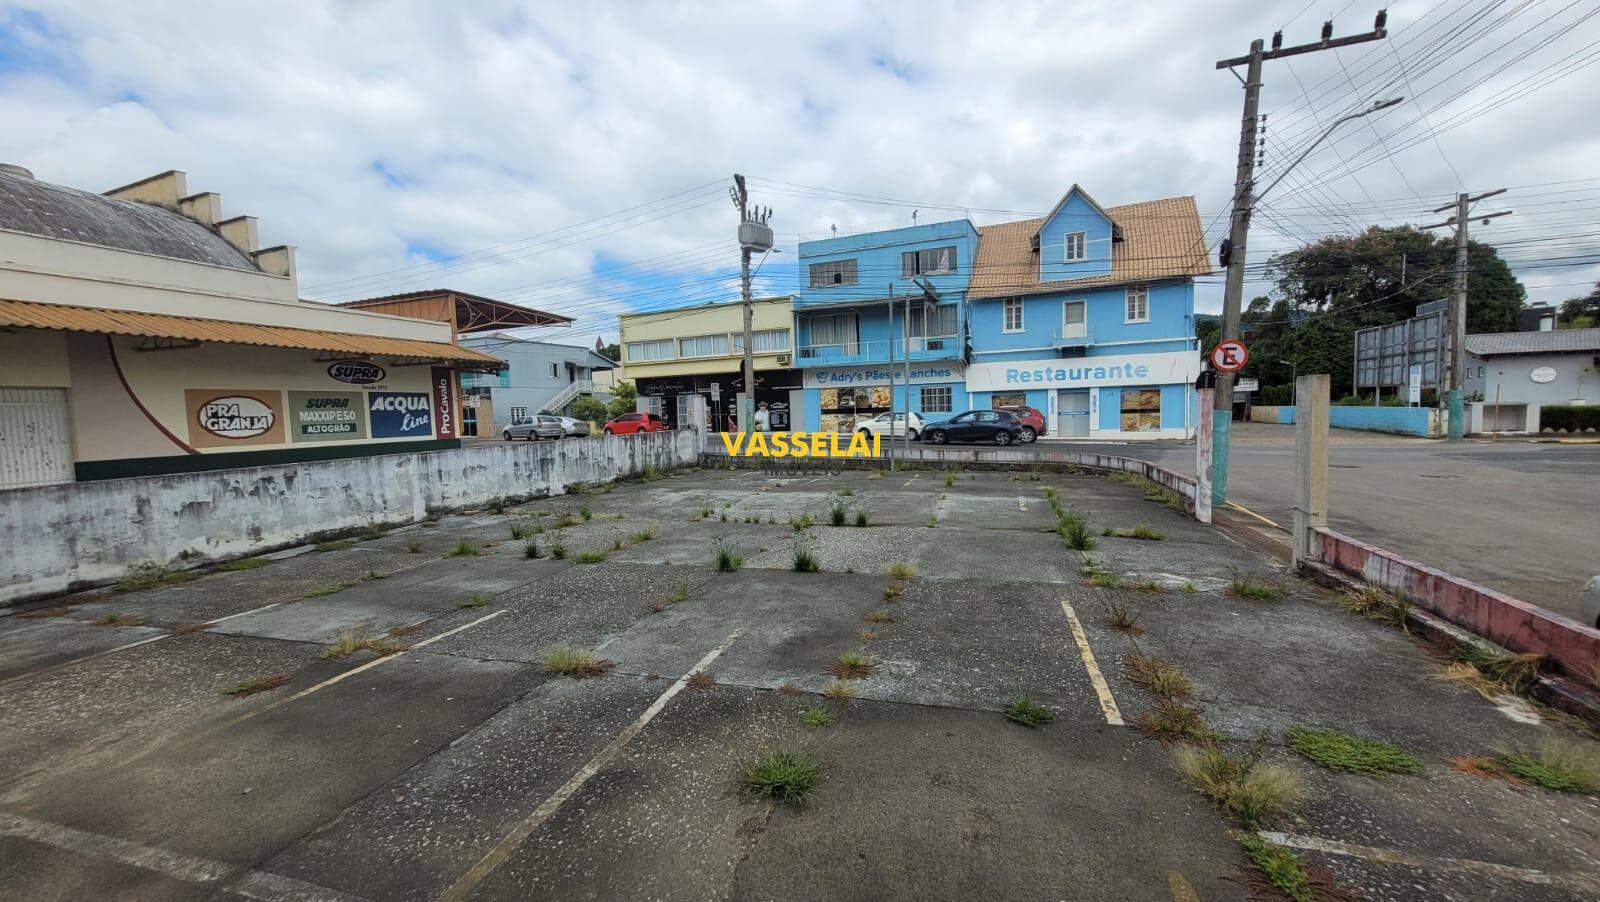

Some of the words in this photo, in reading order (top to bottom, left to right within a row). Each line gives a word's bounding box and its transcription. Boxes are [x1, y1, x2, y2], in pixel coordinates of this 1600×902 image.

[1223, 347, 1237, 365] E
[334, 366, 379, 379] SUPRA
[831, 372, 863, 383] Adry's
[865, 370, 892, 380] Pães
[907, 368, 951, 378] anches
[1006, 363, 1149, 383] Restaurante
[206, 404, 240, 417] PRA
[305, 398, 349, 409] SUPRA
[371, 396, 429, 413] ACQUA
[439, 379, 450, 434] ProCavalo
[299, 410, 356, 421] MAXXIPESO
[400, 413, 430, 432] line
[206, 416, 268, 431] GRANJA
